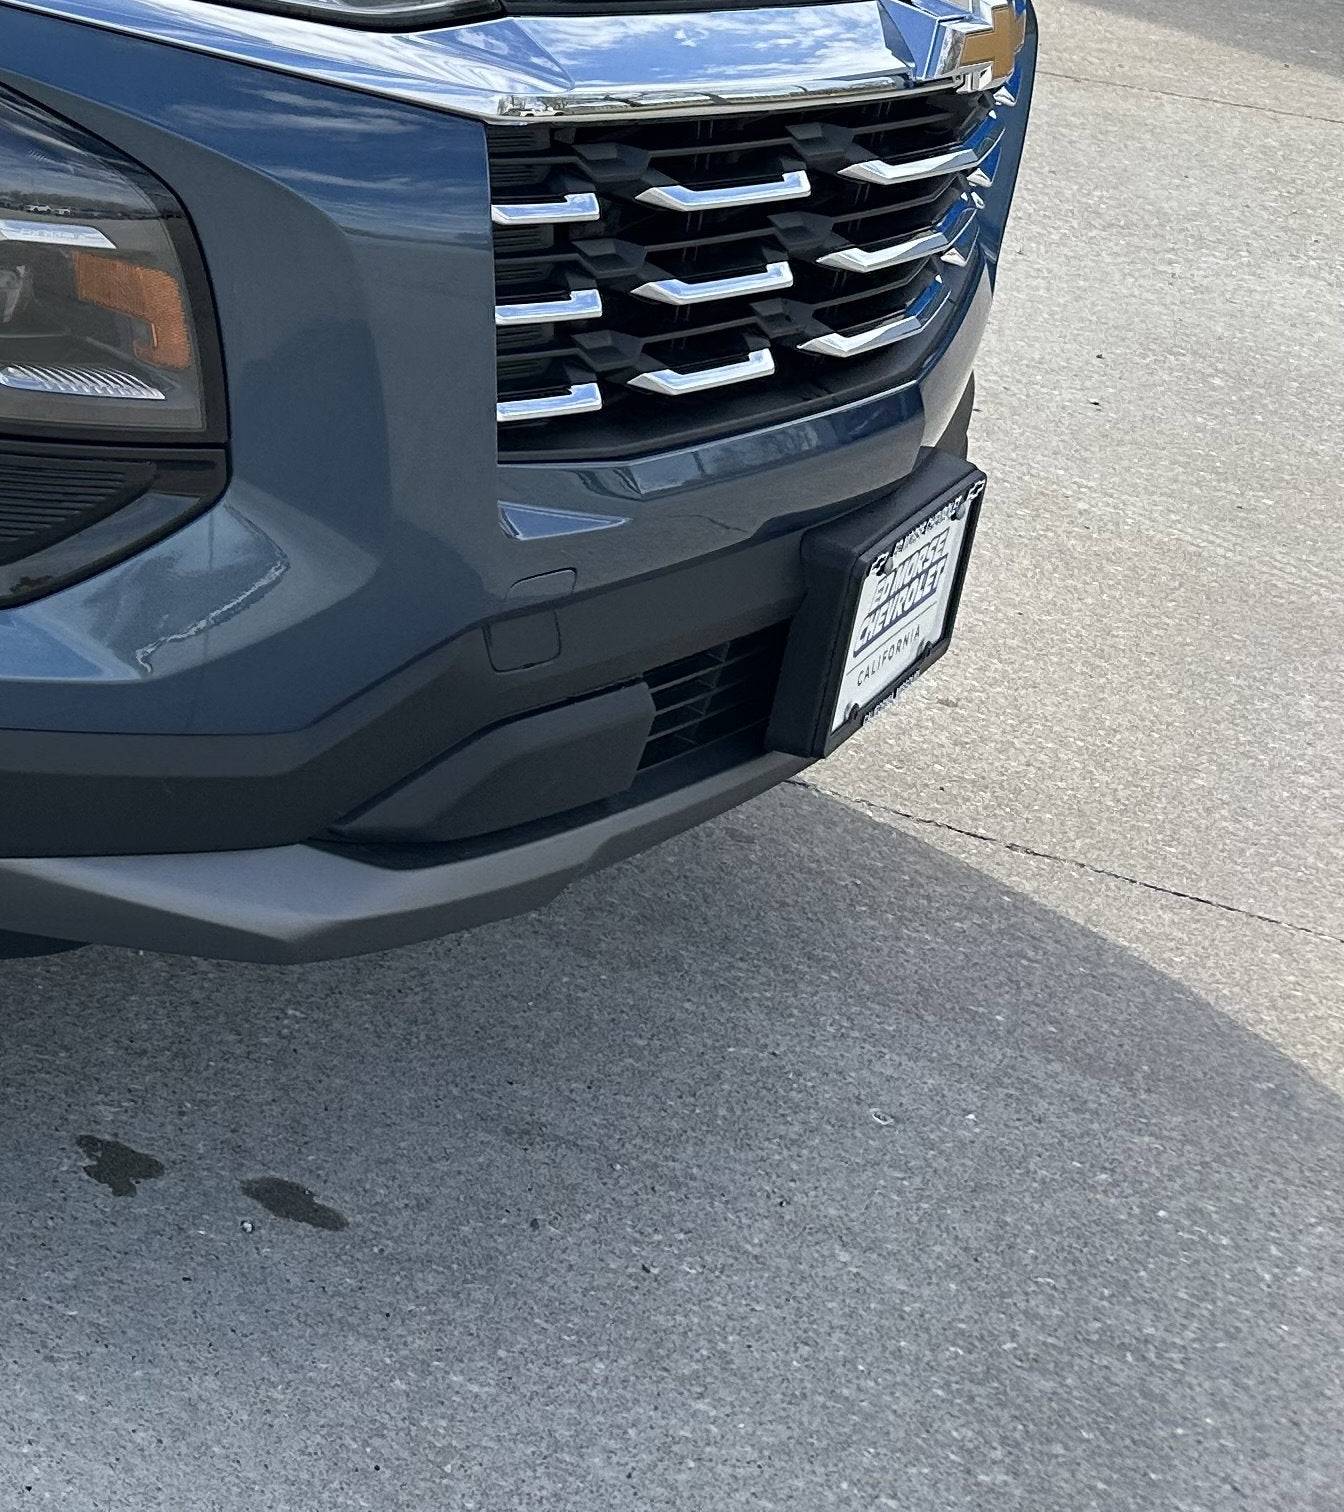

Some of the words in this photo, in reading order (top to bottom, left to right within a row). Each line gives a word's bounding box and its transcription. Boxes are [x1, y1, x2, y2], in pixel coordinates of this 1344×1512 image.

[856, 555, 947, 651] CHEVROLET
[871, 571, 896, 608] ED
[892, 528, 949, 595] MORSE
[857, 624, 921, 687] CALIFORNIA
